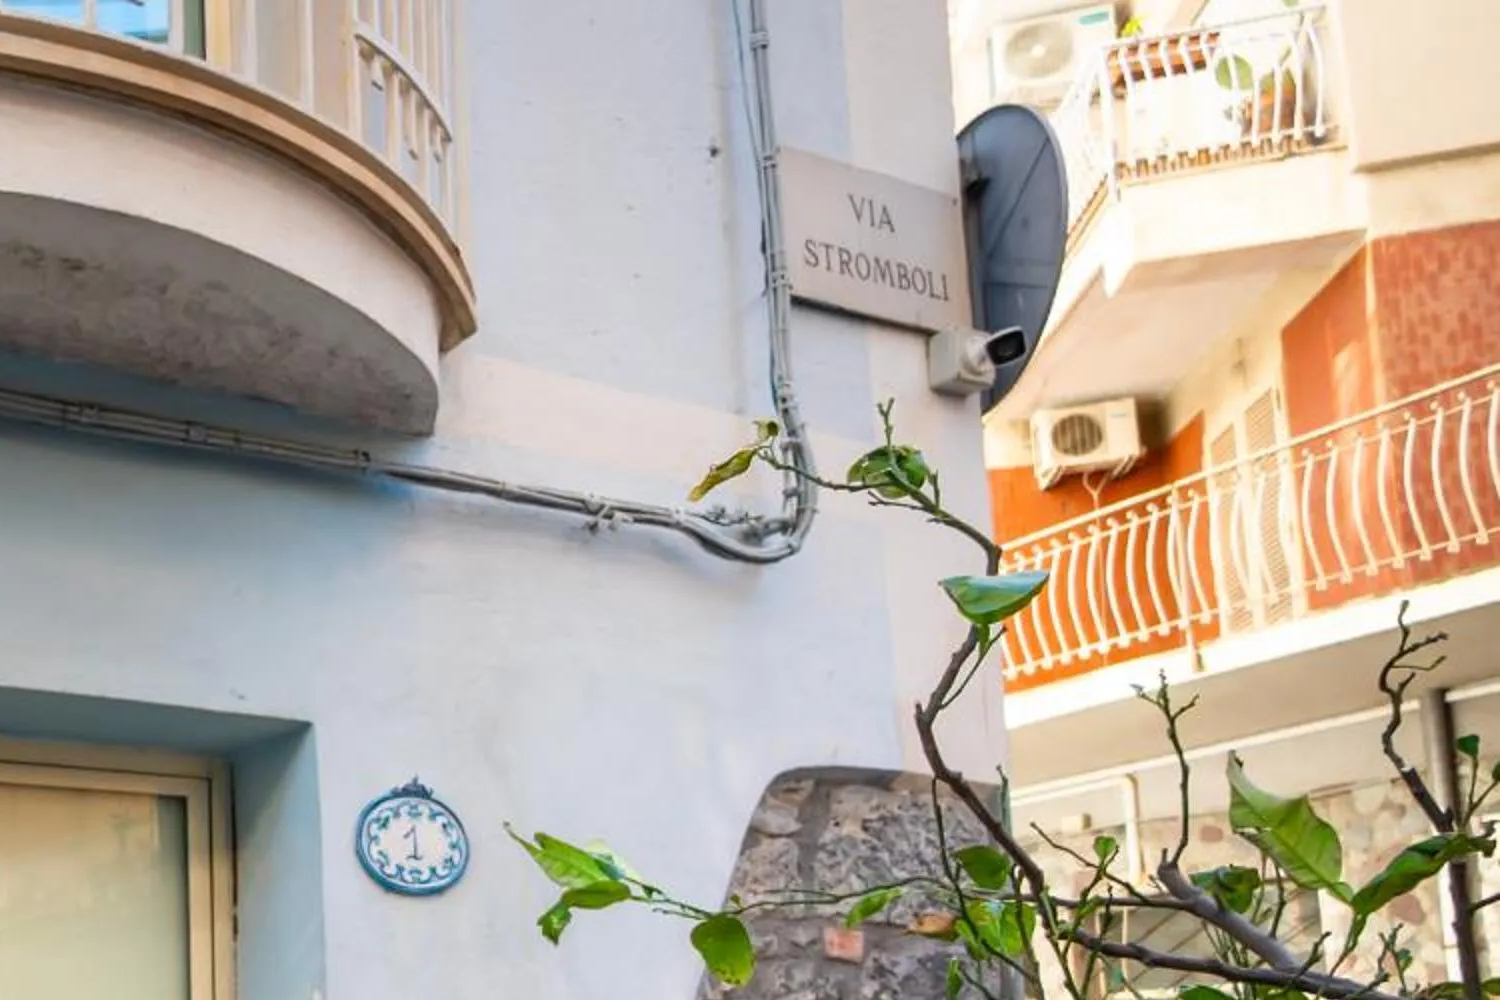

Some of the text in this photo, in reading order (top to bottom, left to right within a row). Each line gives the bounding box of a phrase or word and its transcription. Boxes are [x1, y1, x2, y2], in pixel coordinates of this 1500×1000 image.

[848, 194, 896, 234] VIA
[803, 239, 950, 301] STROMBOLI
[402, 824, 423, 861] 1
